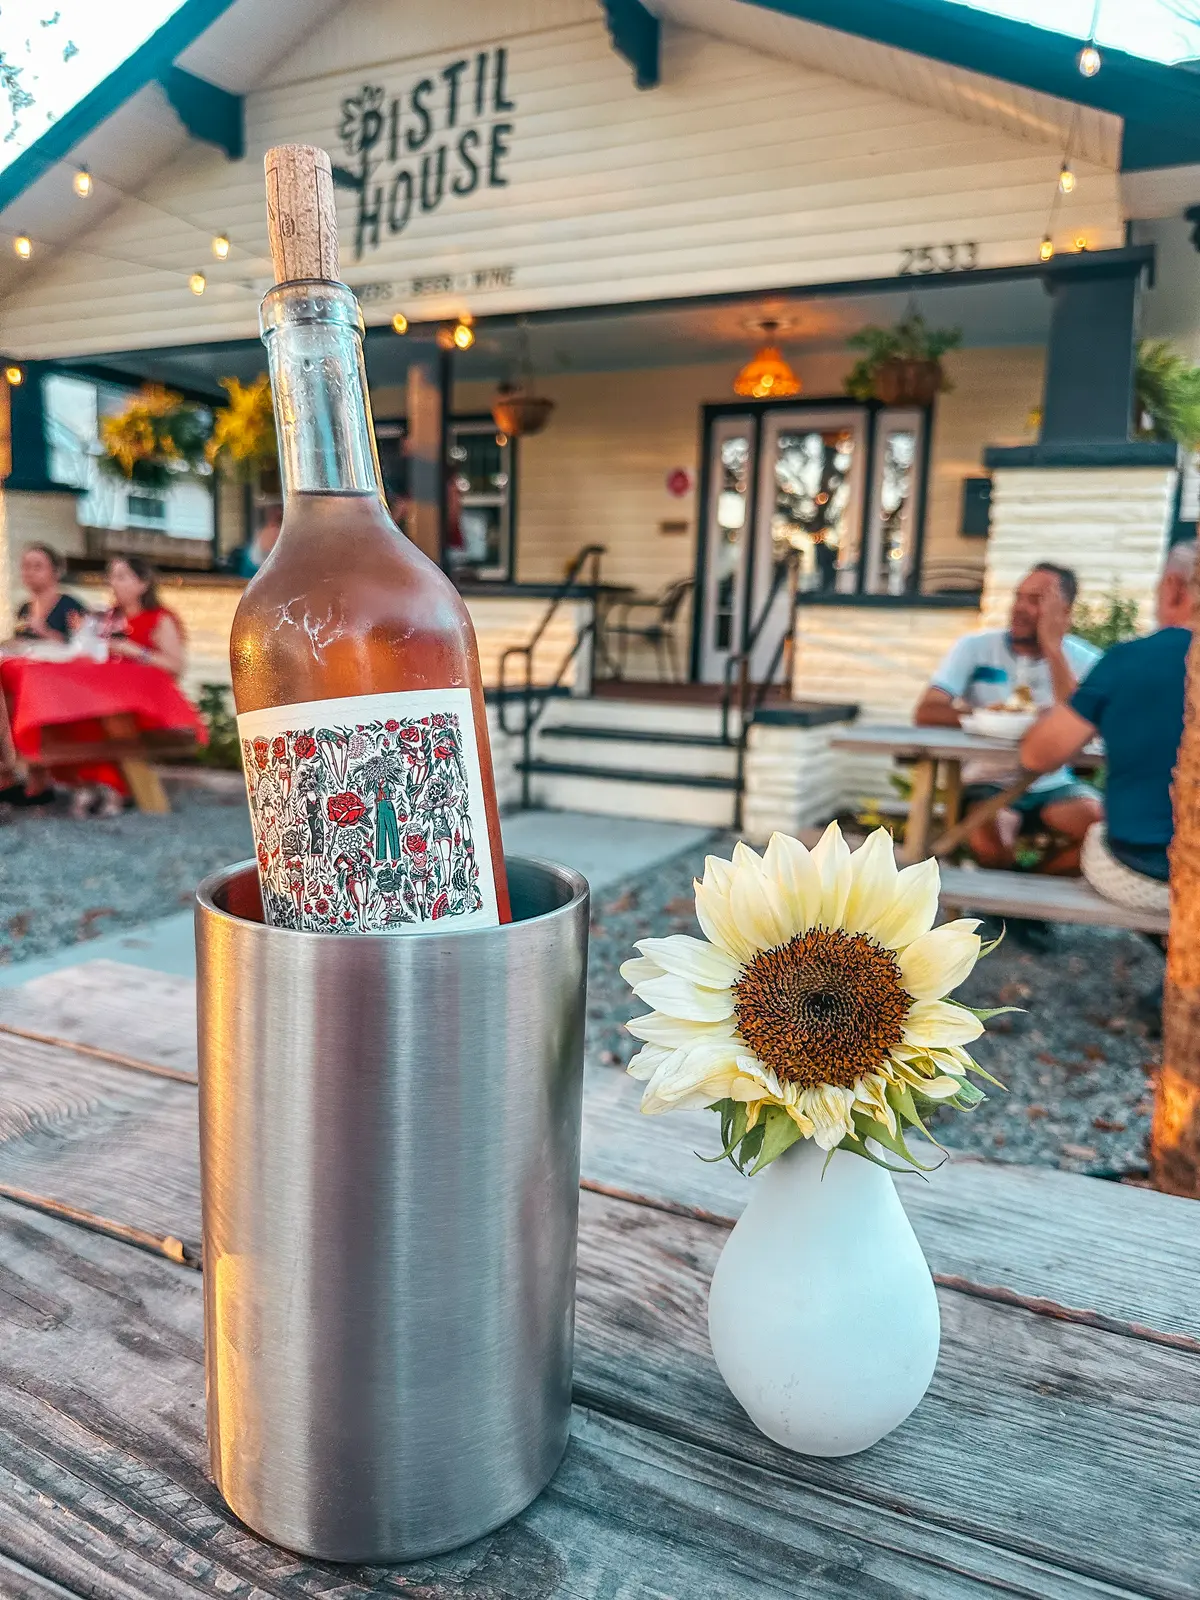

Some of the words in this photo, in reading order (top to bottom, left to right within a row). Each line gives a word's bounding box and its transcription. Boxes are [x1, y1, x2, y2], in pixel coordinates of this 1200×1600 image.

[358, 48, 514, 162] PISTIL
[354, 124, 513, 260] HOUSE
[899, 242, 978, 275] 2533
